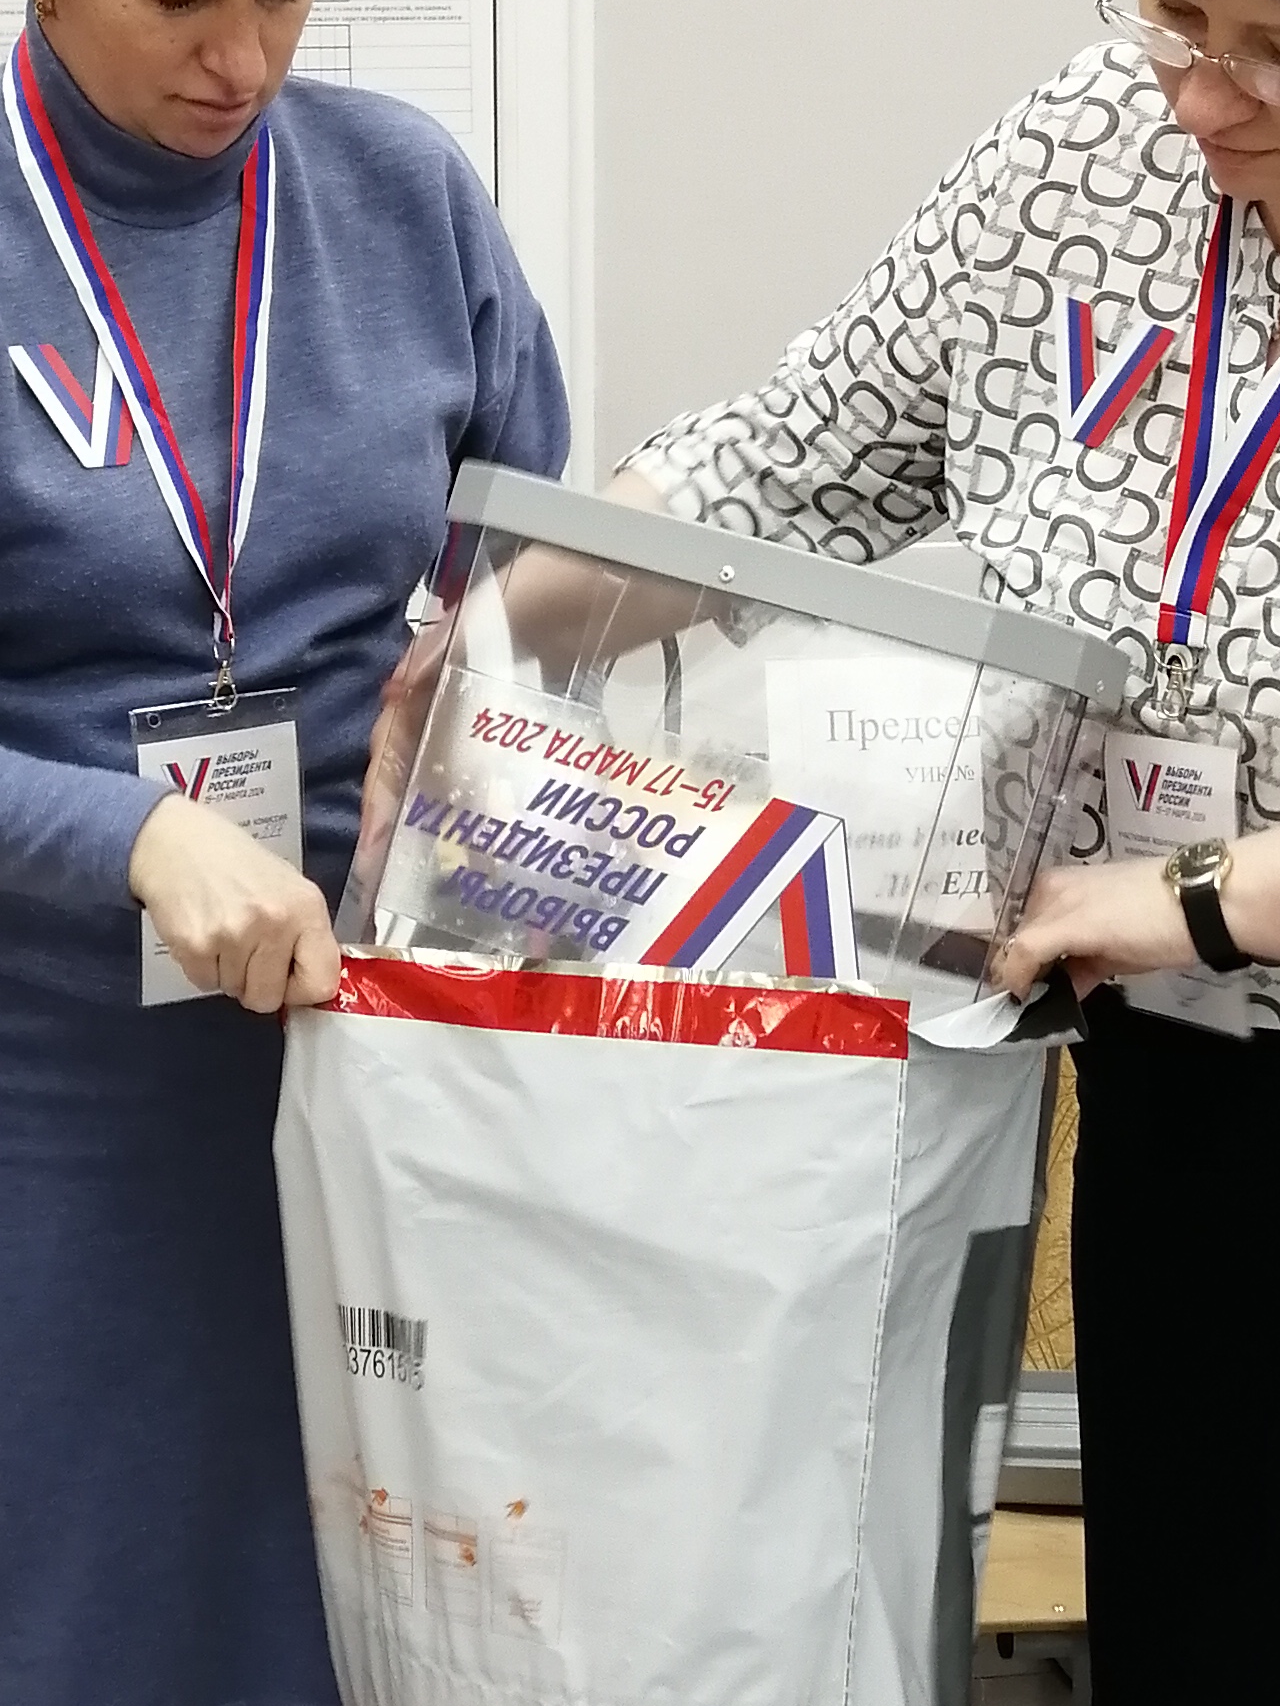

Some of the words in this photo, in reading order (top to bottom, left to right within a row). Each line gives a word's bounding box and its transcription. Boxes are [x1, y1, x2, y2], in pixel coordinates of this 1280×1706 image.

[469, 706, 548, 754] 2024
[216, 749, 259, 766] ВЫБОРЫ
[542, 728, 647, 787] МАРТА
[211, 759, 272, 780] ПРЕЗИДЕНТА
[905, 766, 949, 783] УИК
[954, 765, 975, 782] №
[1165, 765, 1202, 781] ВЫБОРЫ
[207, 777, 248, 793] РОССИИ
[1161, 779, 1213, 798] ПРЕЗИДЕНТА
[1158, 793, 1191, 807] РОССИИ
[526, 777, 705, 858] РОССИИ
[402, 792, 668, 906] ПРЕЗИДЕНТА
[436, 866, 630, 952] ВЫБОРЫ
